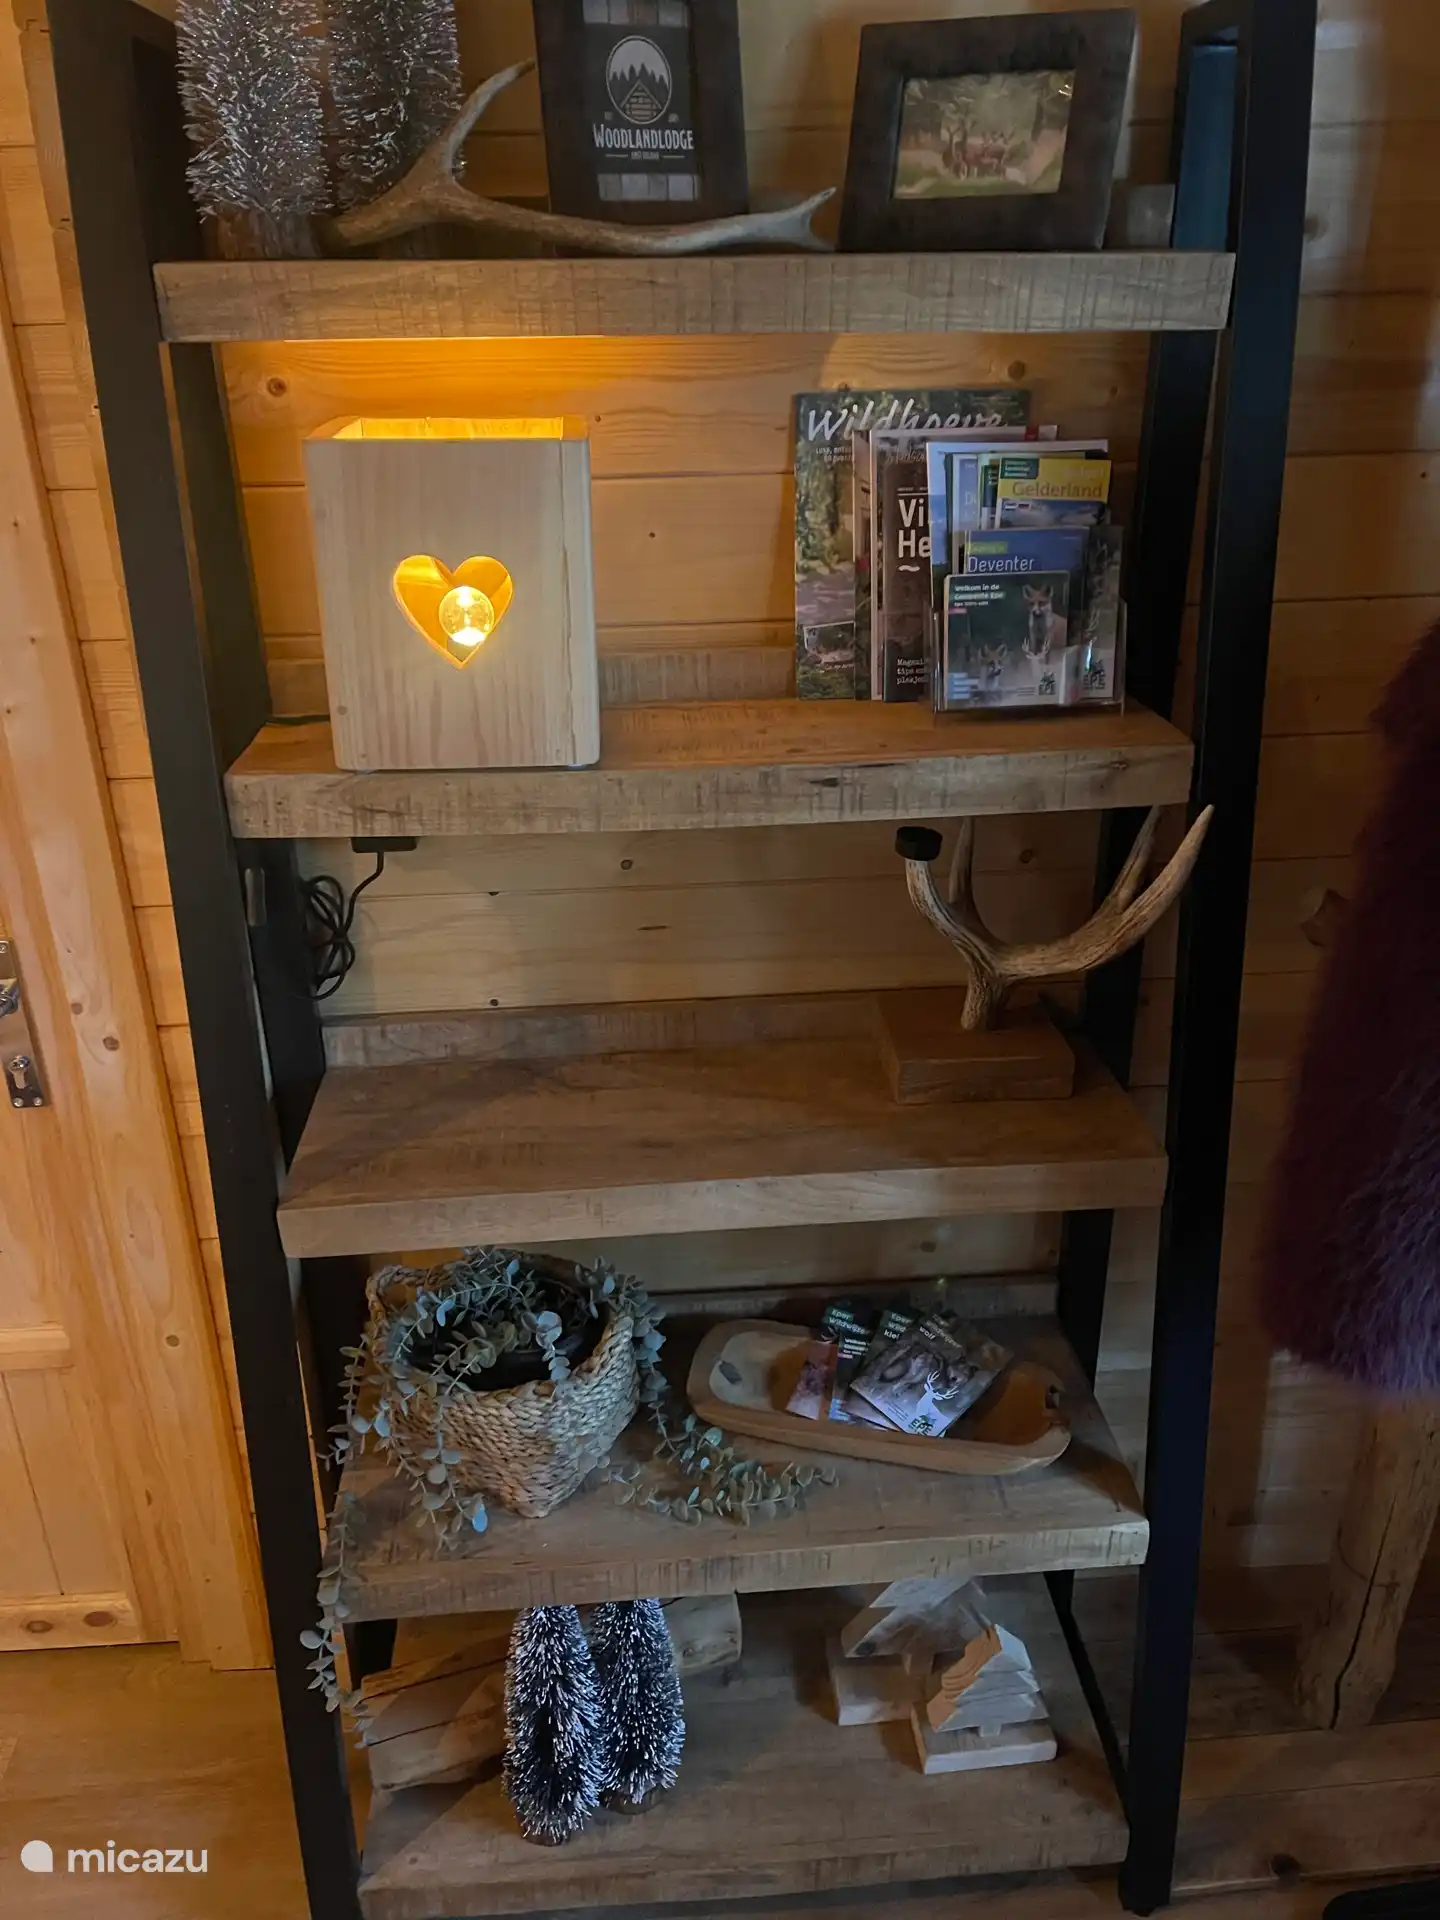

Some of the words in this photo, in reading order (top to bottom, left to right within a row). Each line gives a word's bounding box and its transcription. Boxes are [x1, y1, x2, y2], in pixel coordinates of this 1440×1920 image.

[1012, 482, 1103, 498] Gelderland
[898, 498, 930, 528] Vi
[968, 555, 1035, 573] Deventer
[919, 1325, 937, 1340] wolf
